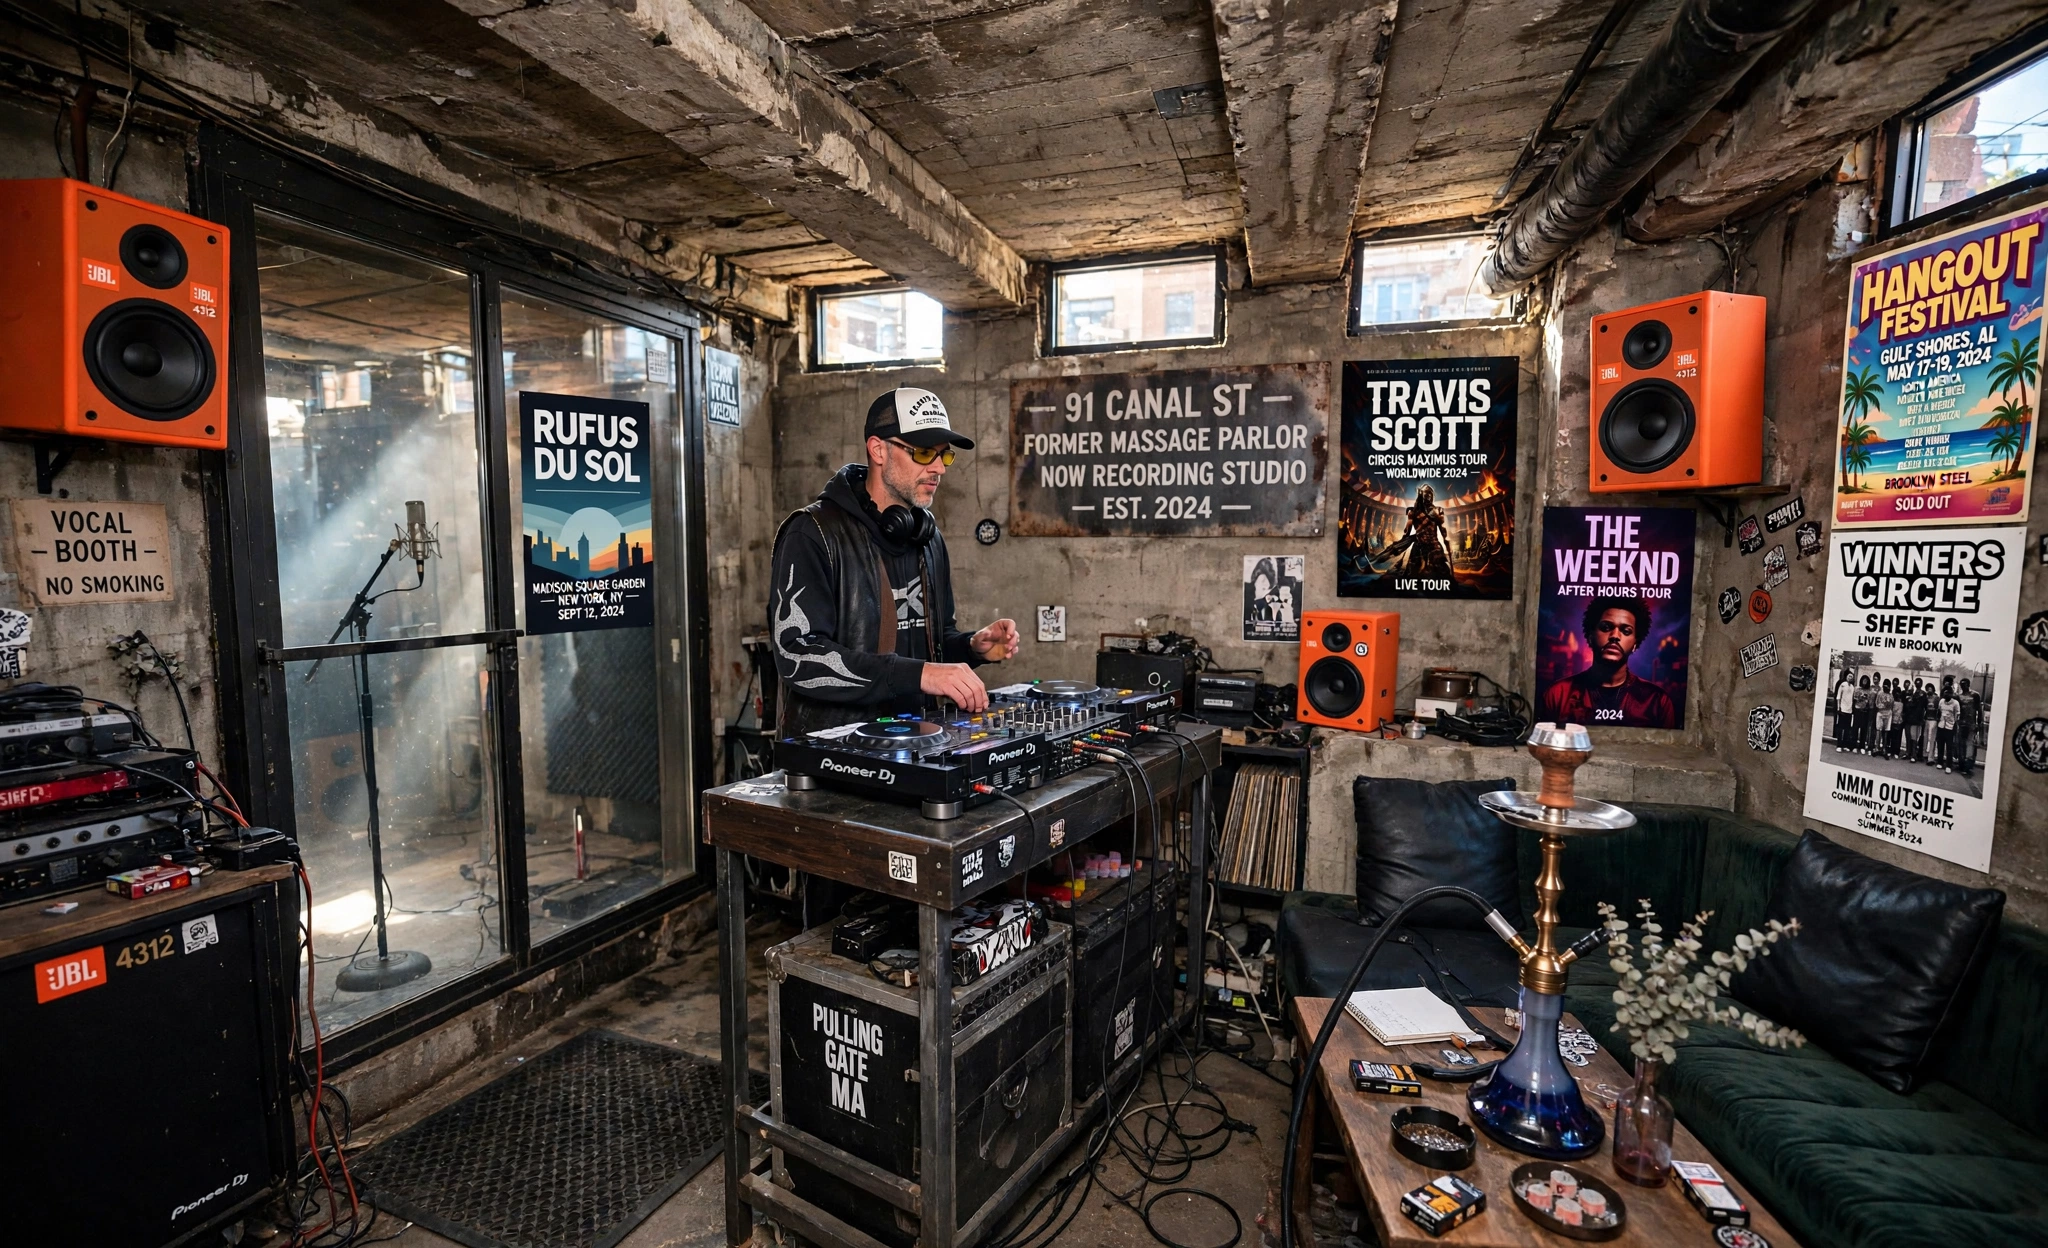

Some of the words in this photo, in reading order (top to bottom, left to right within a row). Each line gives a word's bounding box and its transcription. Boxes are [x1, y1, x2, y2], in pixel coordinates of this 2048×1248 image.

[87, 264, 116, 285] JBL
[1860, 223, 2039, 324] HANGOUT
[193, 287, 214, 303] JBL
[1879, 281, 2006, 341] FESTIVAL
[1880, 344, 1914, 365] GULF
[1916, 331, 1974, 359] SHORES,
[1977, 325, 1998, 345] AL
[1886, 363, 1914, 382] MAY
[1917, 354, 1953, 376] 17-19,
[1956, 346, 1992, 369] 2024
[1065, 391, 1094, 423] 91
[1105, 386, 1202, 421] CANAL
[1213, 383, 1252, 417] ST
[1366, 378, 1491, 415] TRAVIS
[533, 408, 639, 449] RUFUS
[1023, 431, 1103, 456] FORMER
[1110, 427, 1210, 453] MASSAGE
[1218, 424, 1308, 451] PARLOR
[1371, 416, 1487, 451] SCOTT
[534, 447, 577, 481] DU
[584, 449, 641, 483] SOL
[1041, 464, 1086, 488] NOW
[1092, 462, 1214, 487] RECORDING
[1221, 459, 1307, 485] STUDIO
[1368, 454, 1404, 466] CIRCUS
[1407, 454, 1457, 465] MAXIMUS
[1459, 453, 1487, 465] TOUR
[1386, 468, 1441, 479] WORLDWIDE
[1443, 467, 1468, 478] 2024
[1940, 472, 1973, 485] STEEL
[1102, 496, 1147, 520] EST.
[1154, 495, 1212, 519] 2024
[1895, 497, 1924, 511] SOLD
[1927, 495, 1952, 509] OUT
[51, 510, 132, 534] VOCAL
[1585, 515, 1641, 549] THE
[55, 539, 137, 563] BOOTH
[1841, 540, 2005, 580] WINNERS
[1554, 549, 1680, 585] WEEKND
[46, 577, 73, 595] NO
[81, 575, 164, 594] SMOKING
[532, 581, 573, 595] MADISON
[575, 579, 610, 592] SQUARE
[611, 578, 646, 590] GARDEN
[558, 594, 579, 606] NEW
[611, 592, 623, 603] NY
[1395, 579, 1418, 591] LIVE
[1421, 579, 1450, 591] TOUR
[1557, 585, 1594, 597] AFTER
[1597, 585, 1637, 598] HOURS
[1640, 587, 1671, 599] TOUR
[1852, 576, 1981, 613] CIRCLE
[558, 607, 582, 620] SEPT
[584, 606, 598, 620] 12,
[600, 604, 625, 618] 2024
[1865, 613, 1935, 636] SHEFF
[1942, 617, 1959, 638] G
[1858, 635, 1881, 648] LIVE
[1884, 637, 1896, 649] IN
[1899, 638, 1962, 655] BROOKLYN
[1595, 708, 1623, 720] 2024
[820, 757, 876, 780] Pioneer
[988, 748, 1024, 765] Pioneer
[1836, 771, 1873, 798] NMM
[1879, 782, 1954, 818] OUTSIDE
[1831, 791, 1885, 812] COMMUNITY
[1886, 804, 1918, 822] BLOCK
[1921, 814, 1954, 831] PARTY
[1865, 810, 1895, 827] CANAL
[1897, 819, 1910, 830] ST
[1857, 818, 1895, 838] SUMMER
[1898, 829, 1922, 845] 2024
[46, 960, 98, 990] JBL
[115, 933, 175, 970] 4312
[812, 1002, 883, 1057] PULLING
[825, 1039, 868, 1083] GATE
[831, 1071, 867, 1119] MA
[171, 1182, 230, 1221] Pioneer
